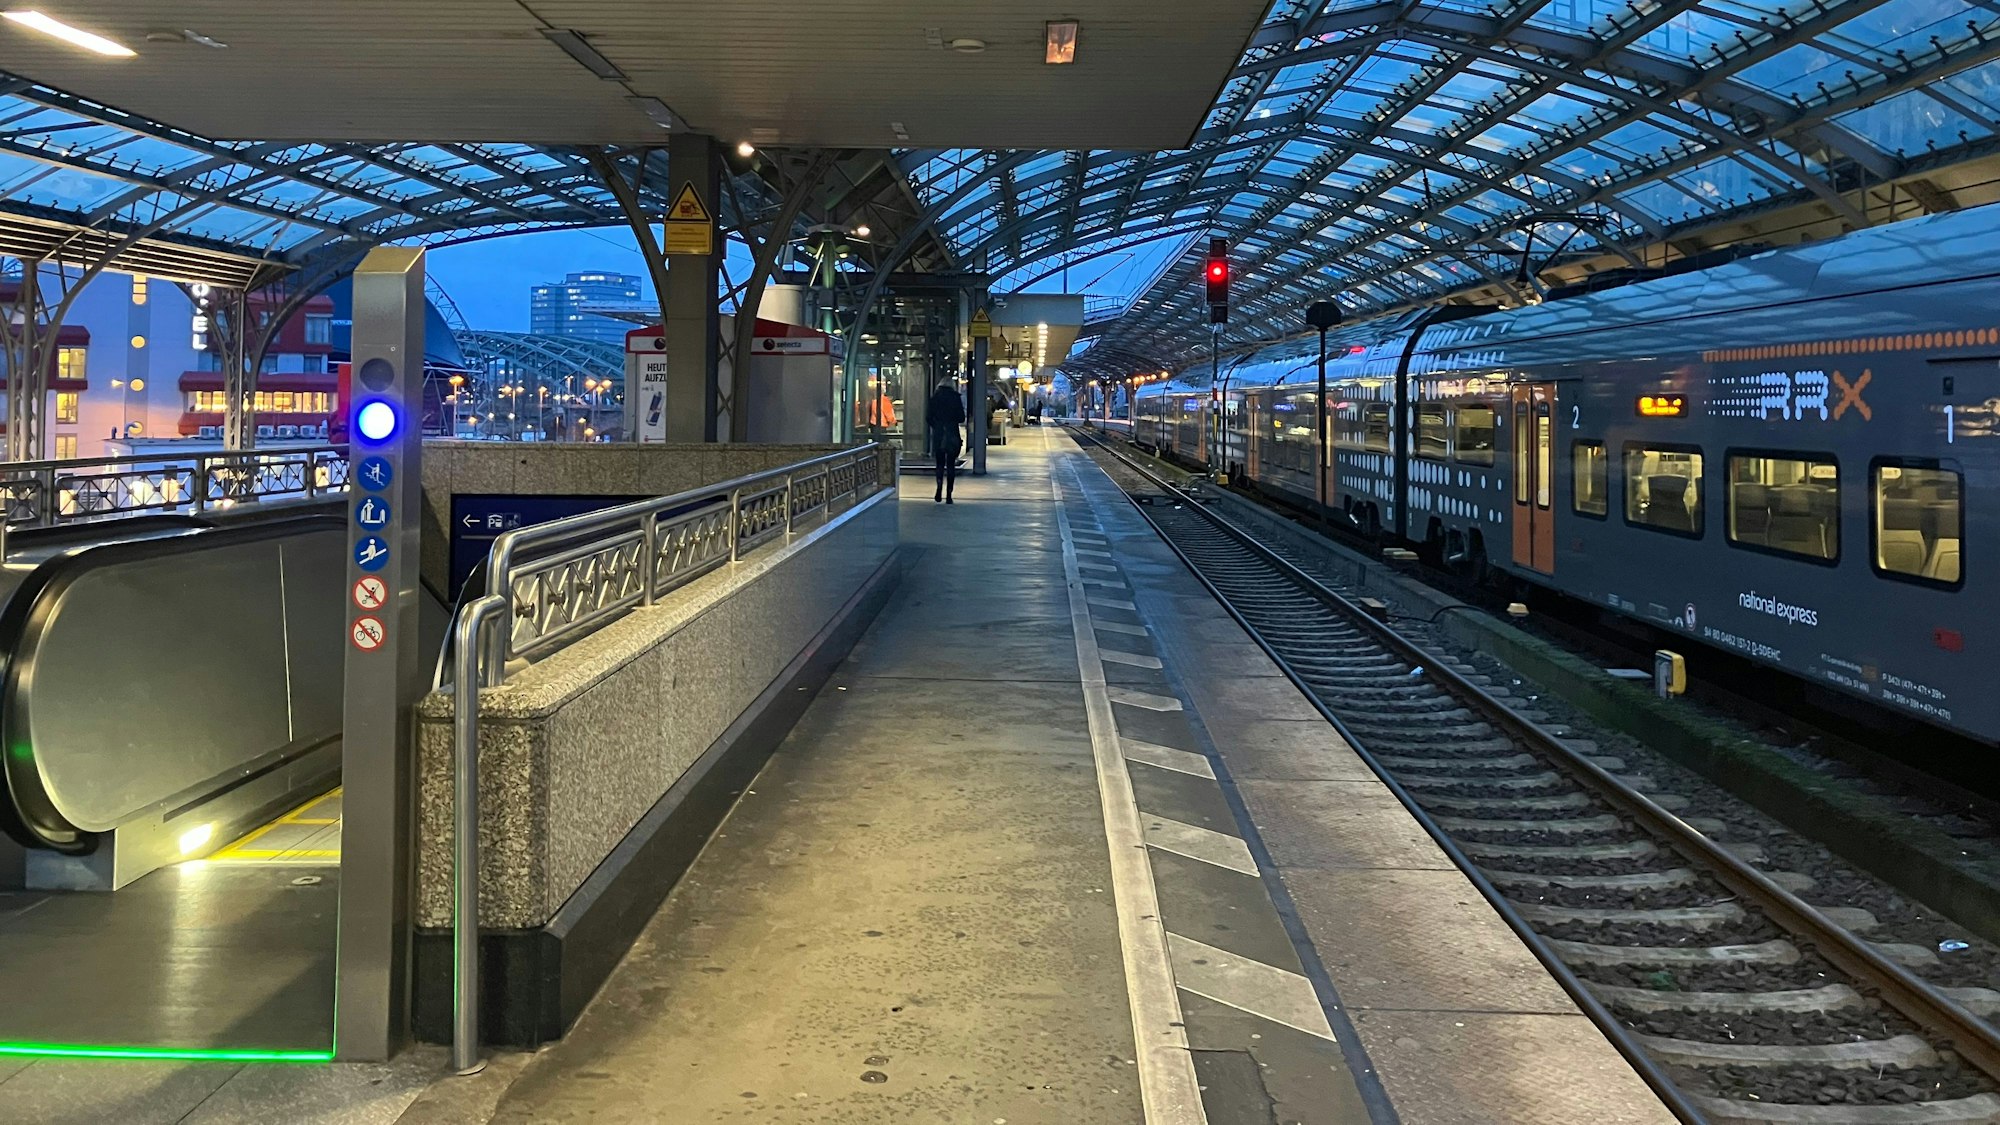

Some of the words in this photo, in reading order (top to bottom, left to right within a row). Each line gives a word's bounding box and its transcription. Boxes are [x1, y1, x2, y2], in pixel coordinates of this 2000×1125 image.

[1571, 405, 1581, 429] 2
[1943, 404, 1955, 444] 1
[1739, 590, 1776, 615] national
[1776, 602, 1818, 626] express
